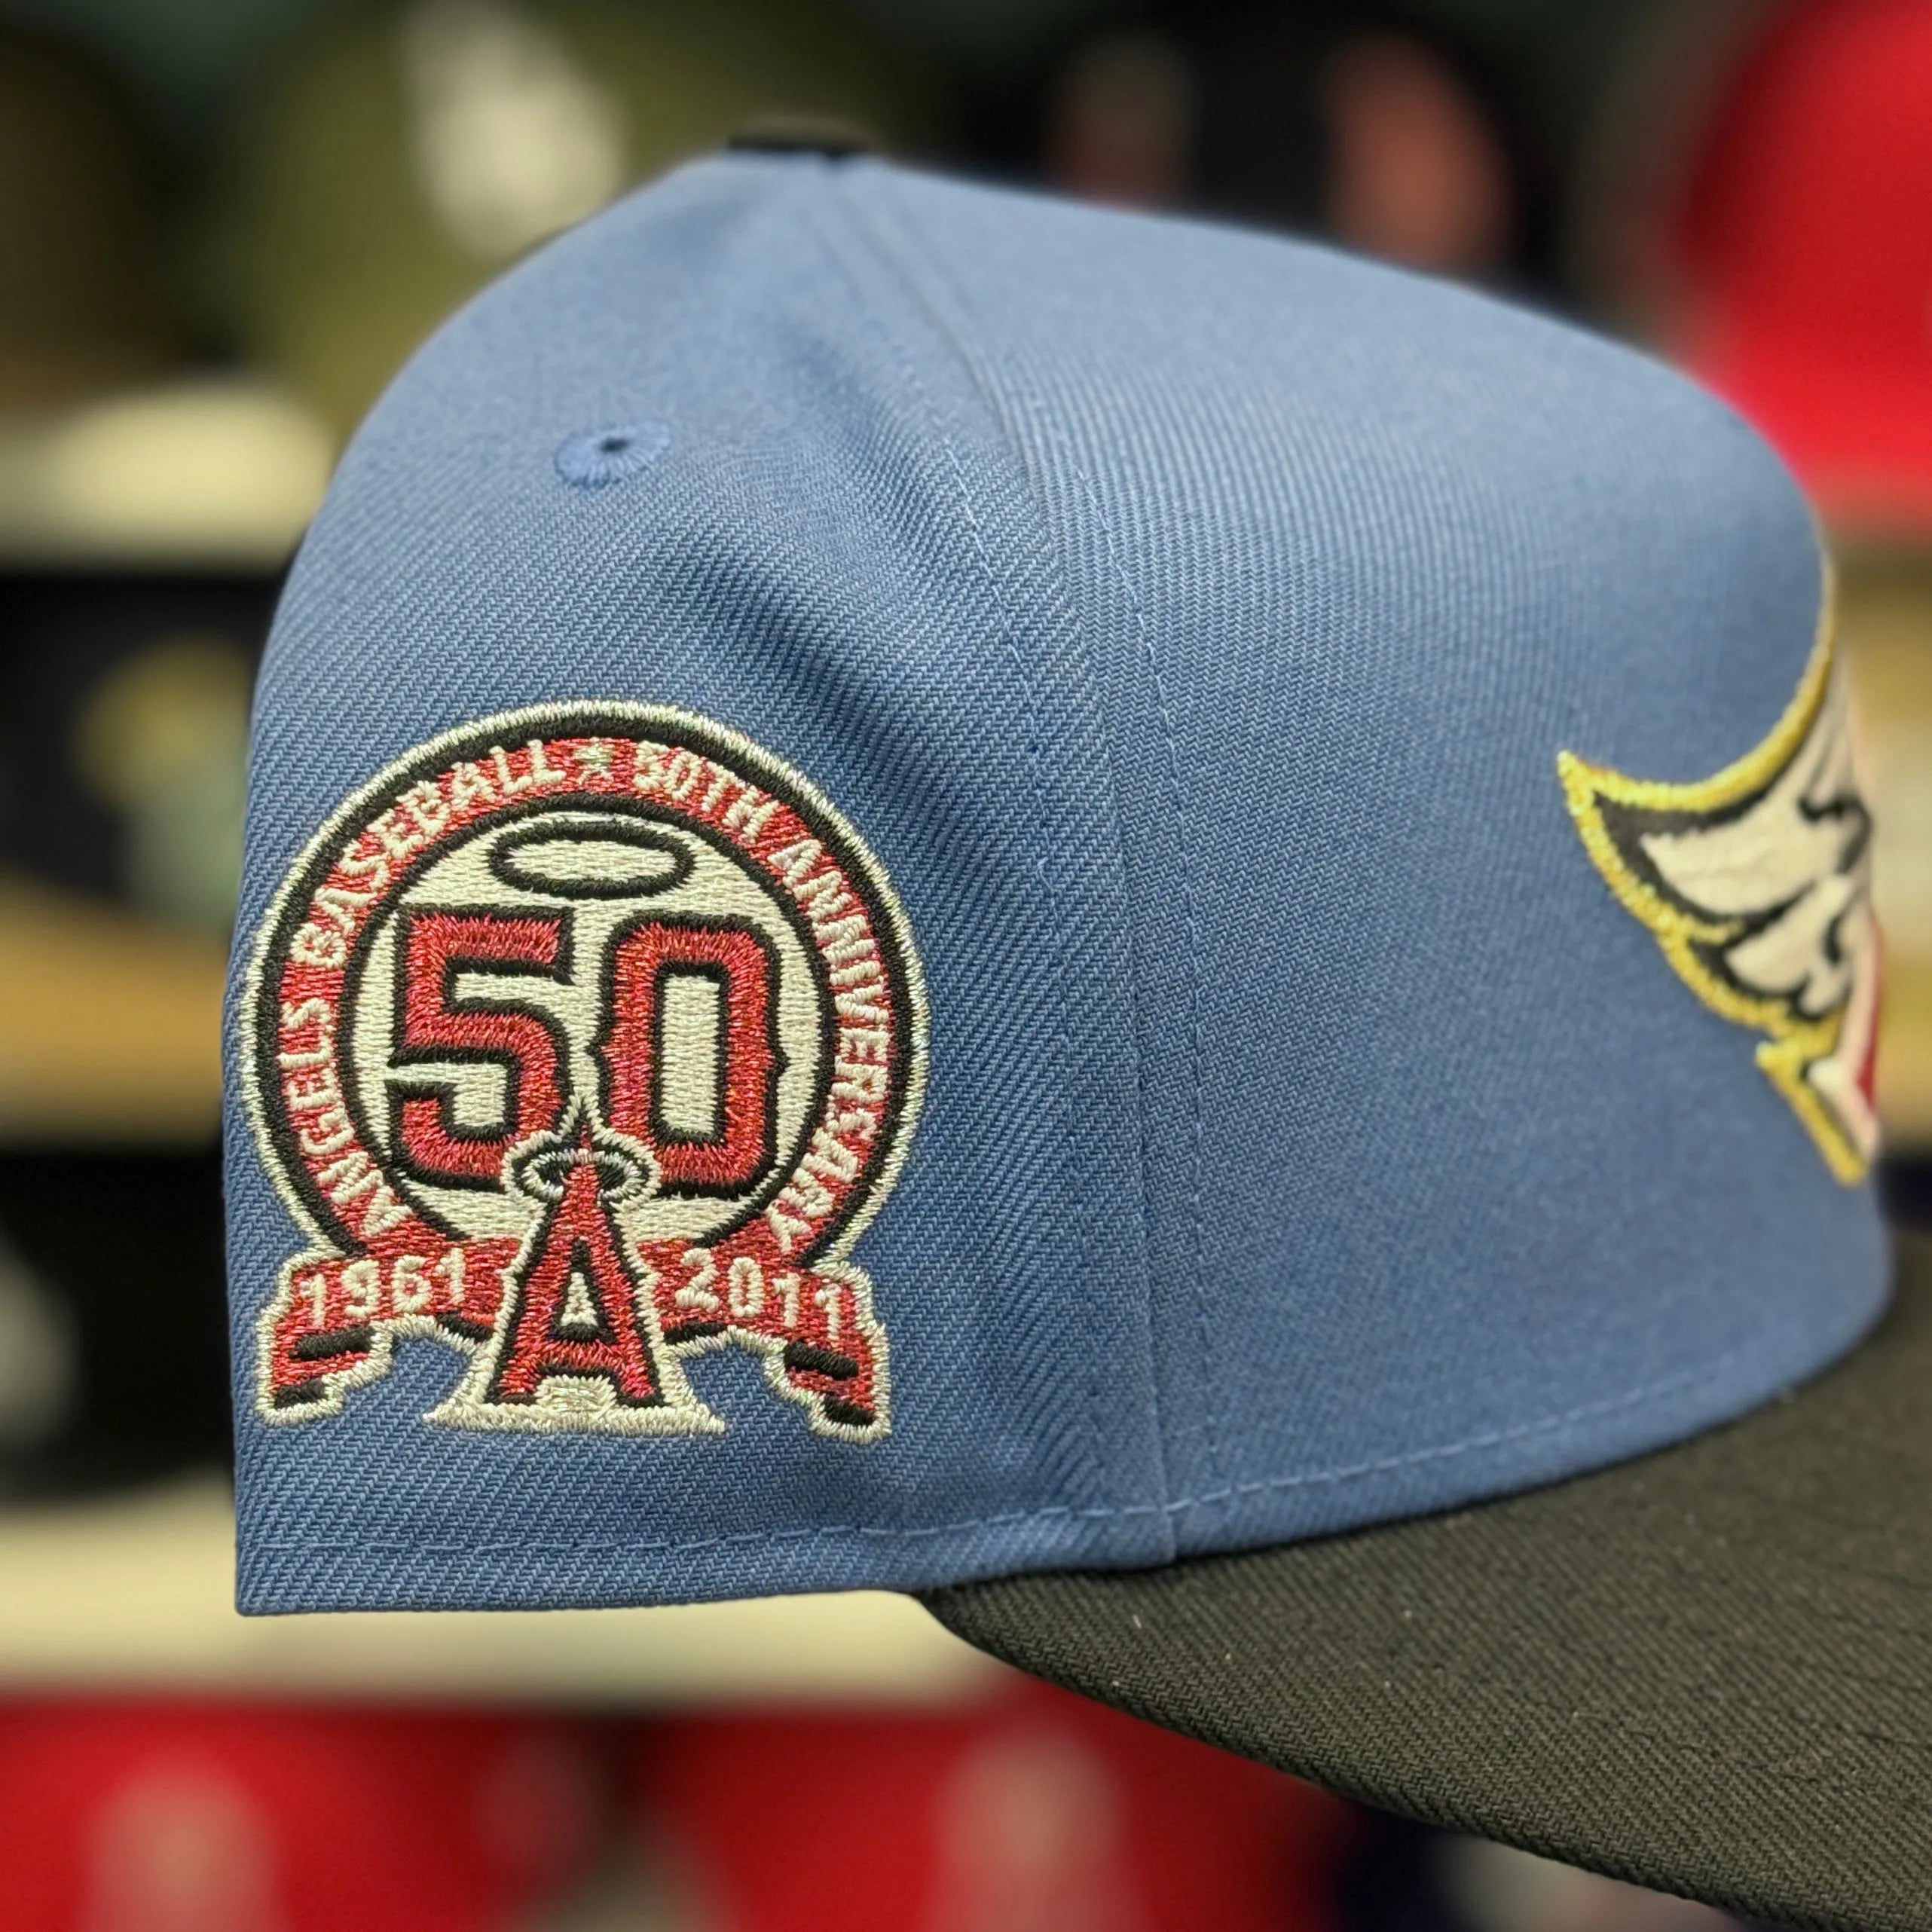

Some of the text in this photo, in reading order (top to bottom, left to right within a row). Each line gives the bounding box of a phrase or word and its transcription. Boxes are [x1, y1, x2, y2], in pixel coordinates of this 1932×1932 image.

[277, 740, 566, 1237] ANGELS BASEBALL
[390, 908, 783, 1195] 50
[634, 741, 890, 1248] 50TH ANNIVERSARY
[299, 1248, 842, 1340] 1961 2011
[494, 1130, 662, 1405] A
